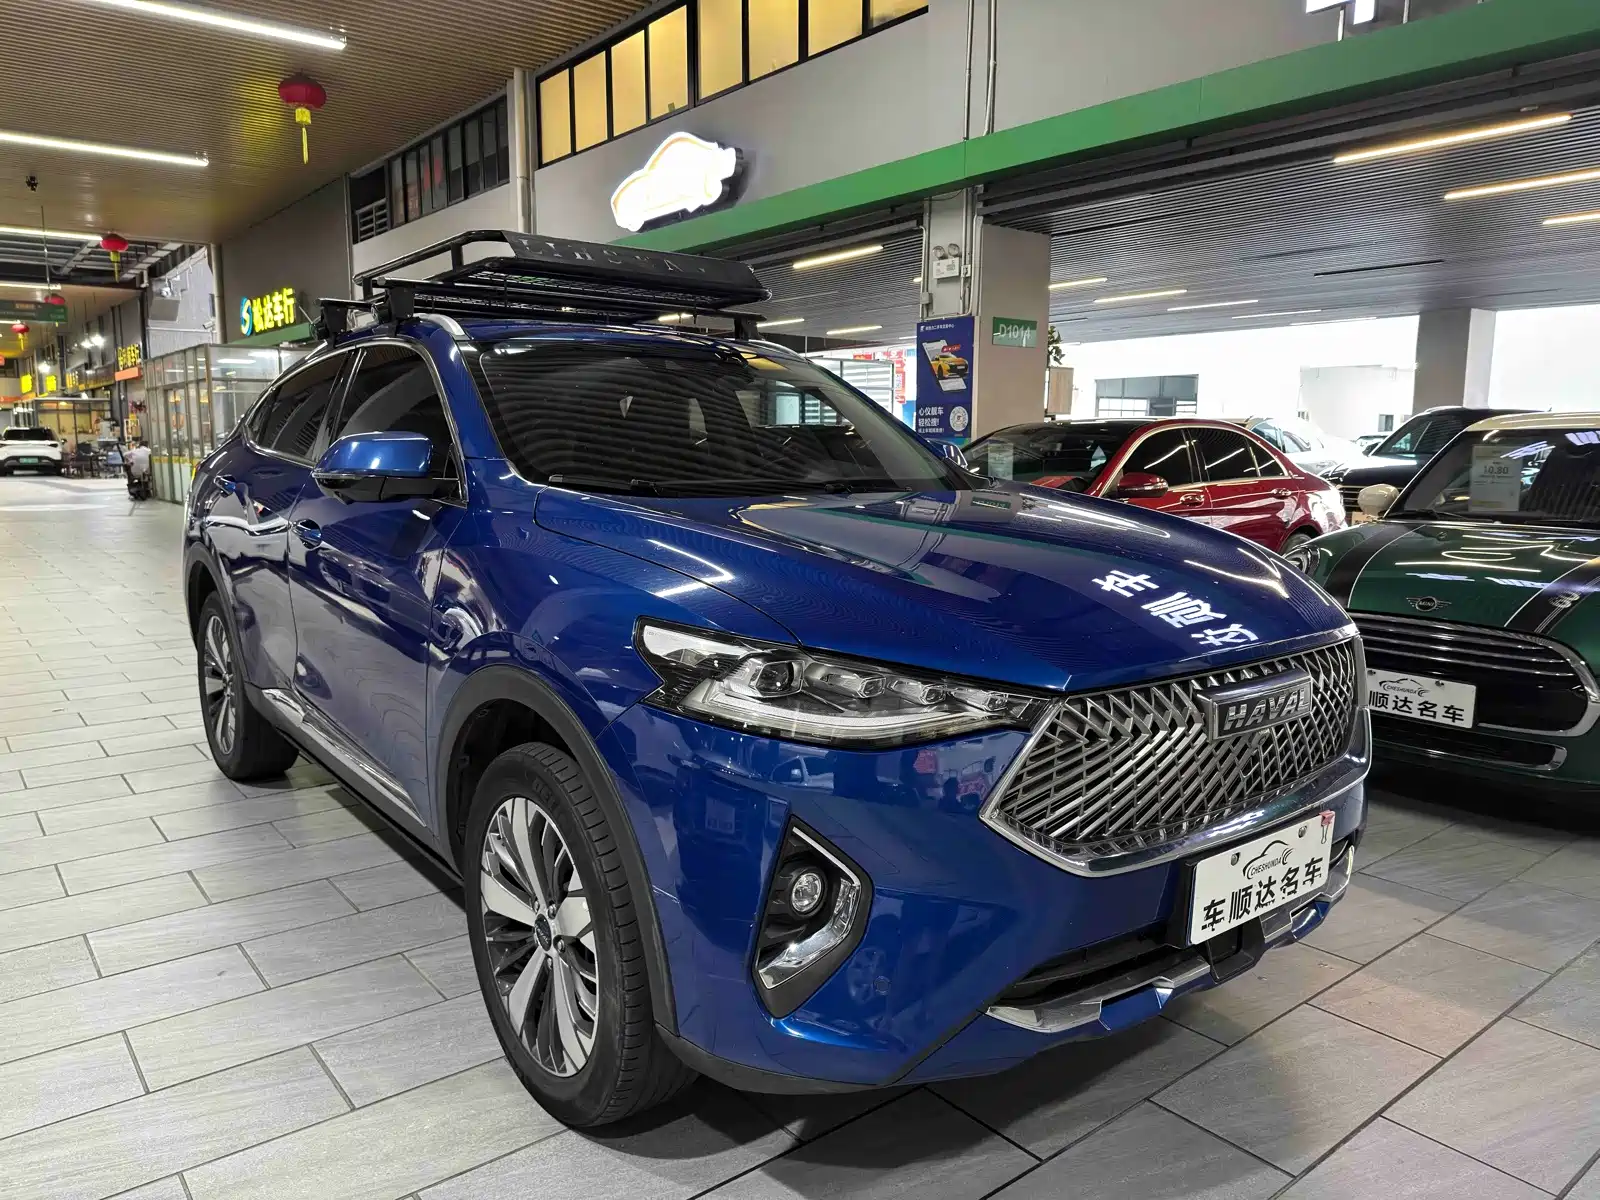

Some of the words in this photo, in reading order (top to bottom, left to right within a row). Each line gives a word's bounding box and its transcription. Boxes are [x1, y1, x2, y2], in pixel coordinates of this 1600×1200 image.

[999, 323, 1031, 340] D1014
[1223, 687, 1310, 731] HAVAL
[1250, 856, 1283, 876] CHESHUNDA
[1201, 856, 1324, 932] 车顺达名车
